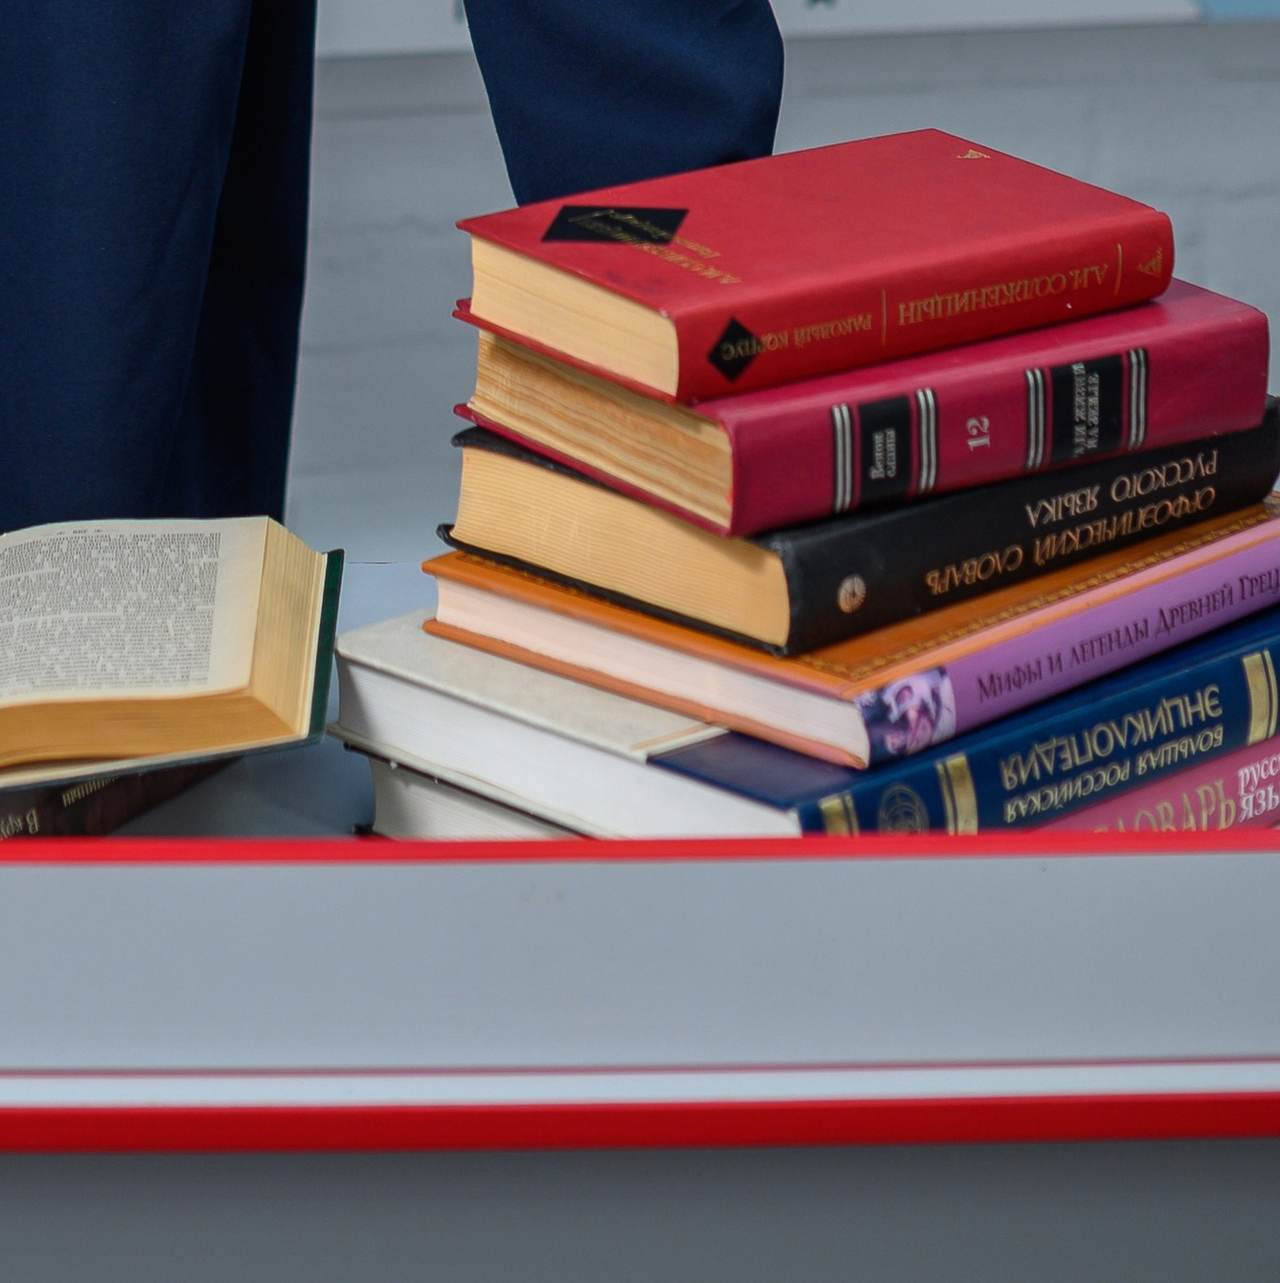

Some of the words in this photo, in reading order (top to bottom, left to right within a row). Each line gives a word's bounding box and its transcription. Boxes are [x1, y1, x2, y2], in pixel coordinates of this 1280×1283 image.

[898, 274, 1067, 327] СОЛЖЕНИЦЫН
[966, 415, 990, 452] 12
[1111, 450, 1219, 503] РУССКОГО
[1025, 485, 1100, 528] ЯЗЫКА
[1033, 487, 1216, 567] ОРФОЭПИЧЕСКИЙ
[924, 544, 1023, 596] СЛОВАРЬ
[999, 684, 1223, 791] ЭНЦИКЛОПЕДИЯ
[1137, 723, 1224, 776] БОЛЬШАЯ
[1004, 760, 1131, 823] РОССИЙСКАЯ
[1236, 753, 1280, 797] русс
[26, 807, 40, 834] В
